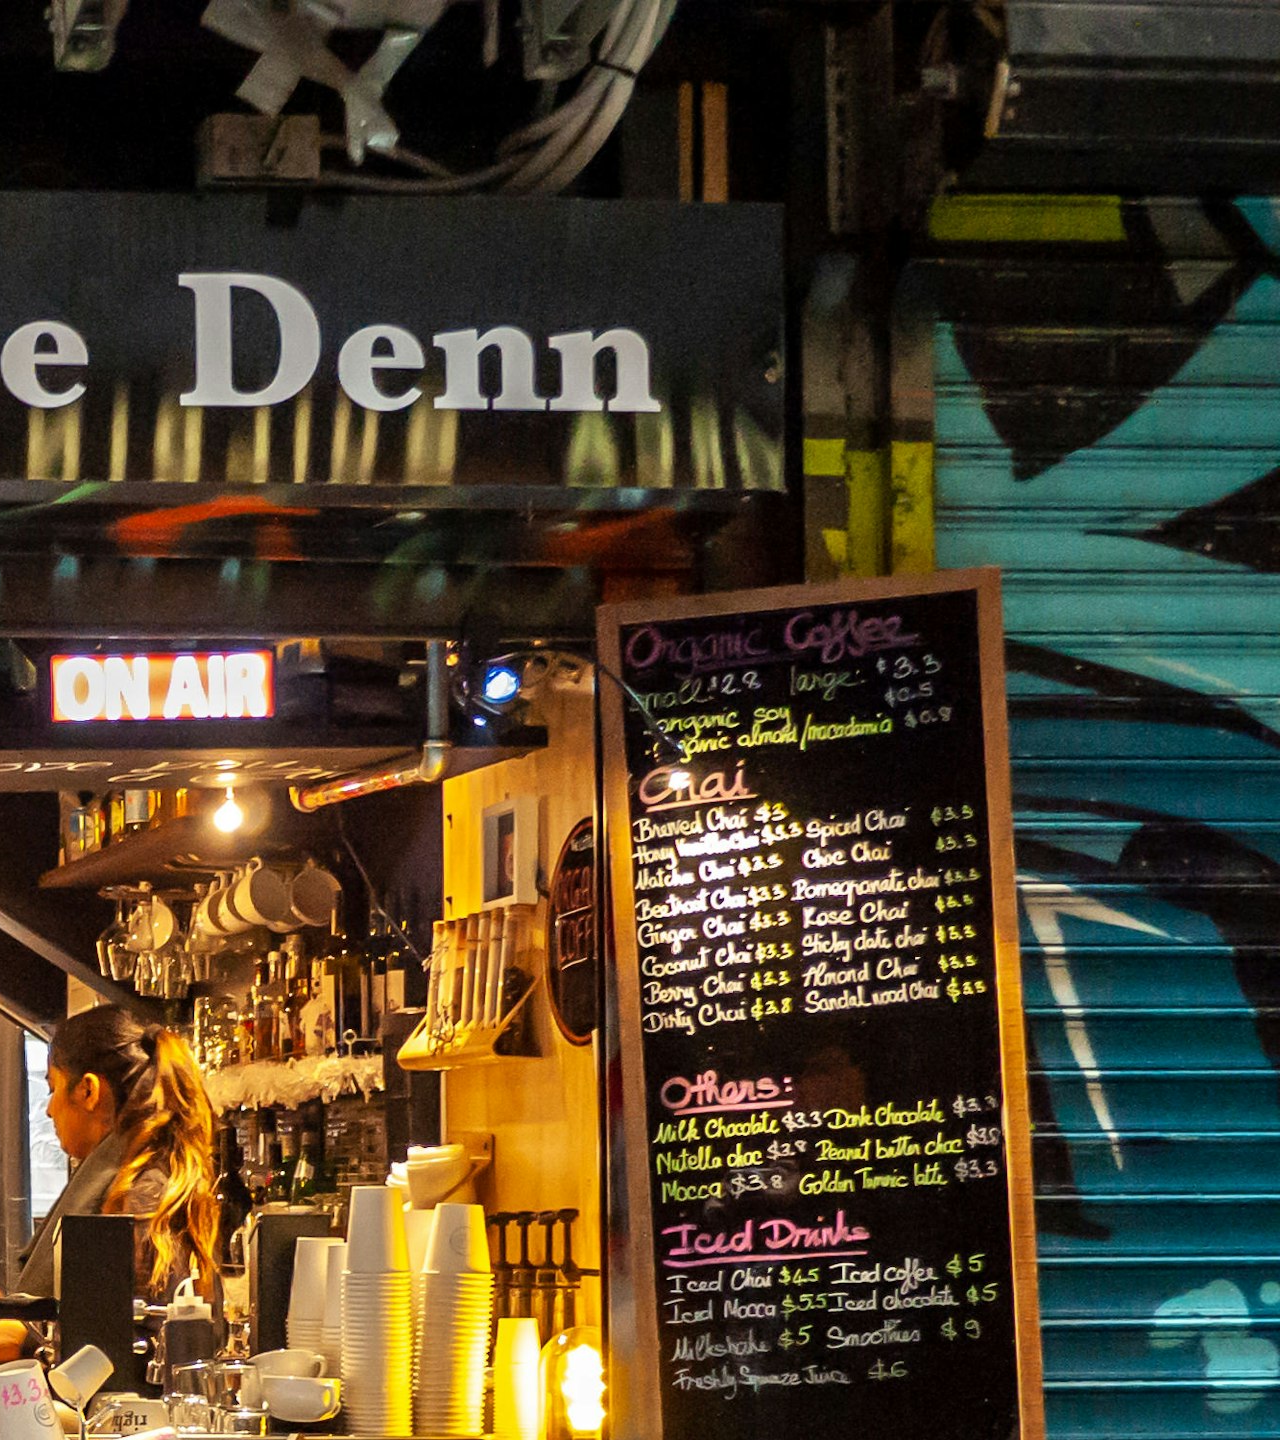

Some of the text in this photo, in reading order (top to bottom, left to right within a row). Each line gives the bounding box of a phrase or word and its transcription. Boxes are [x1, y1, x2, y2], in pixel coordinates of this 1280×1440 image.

[178, 273, 662, 413] Denn
[627, 626, 768, 672] Organic
[56, 653, 267, 721] ON AIR
[707, 808, 748, 833] Chai
[806, 807, 909, 850] Spiced Chai
[851, 841, 892, 862] Chai
[703, 913, 745, 938] Chai
[860, 902, 908, 924] Chai
[642, 941, 754, 978] Coconut Chai
[877, 957, 920, 980] Chai
[700, 999, 746, 1025] Chai
[705, 1114, 780, 1139] Chocolate
[876, 1100, 944, 1127] Chocolate
[662, 1180, 722, 1203] Mocca
[662, 1220, 754, 1255] Iced
[667, 1273, 724, 1294] Iced
[731, 1266, 773, 1292] Chai
[829, 1262, 881, 1284] Iced
[666, 1293, 878, 1325] Iced Mocca Iced
